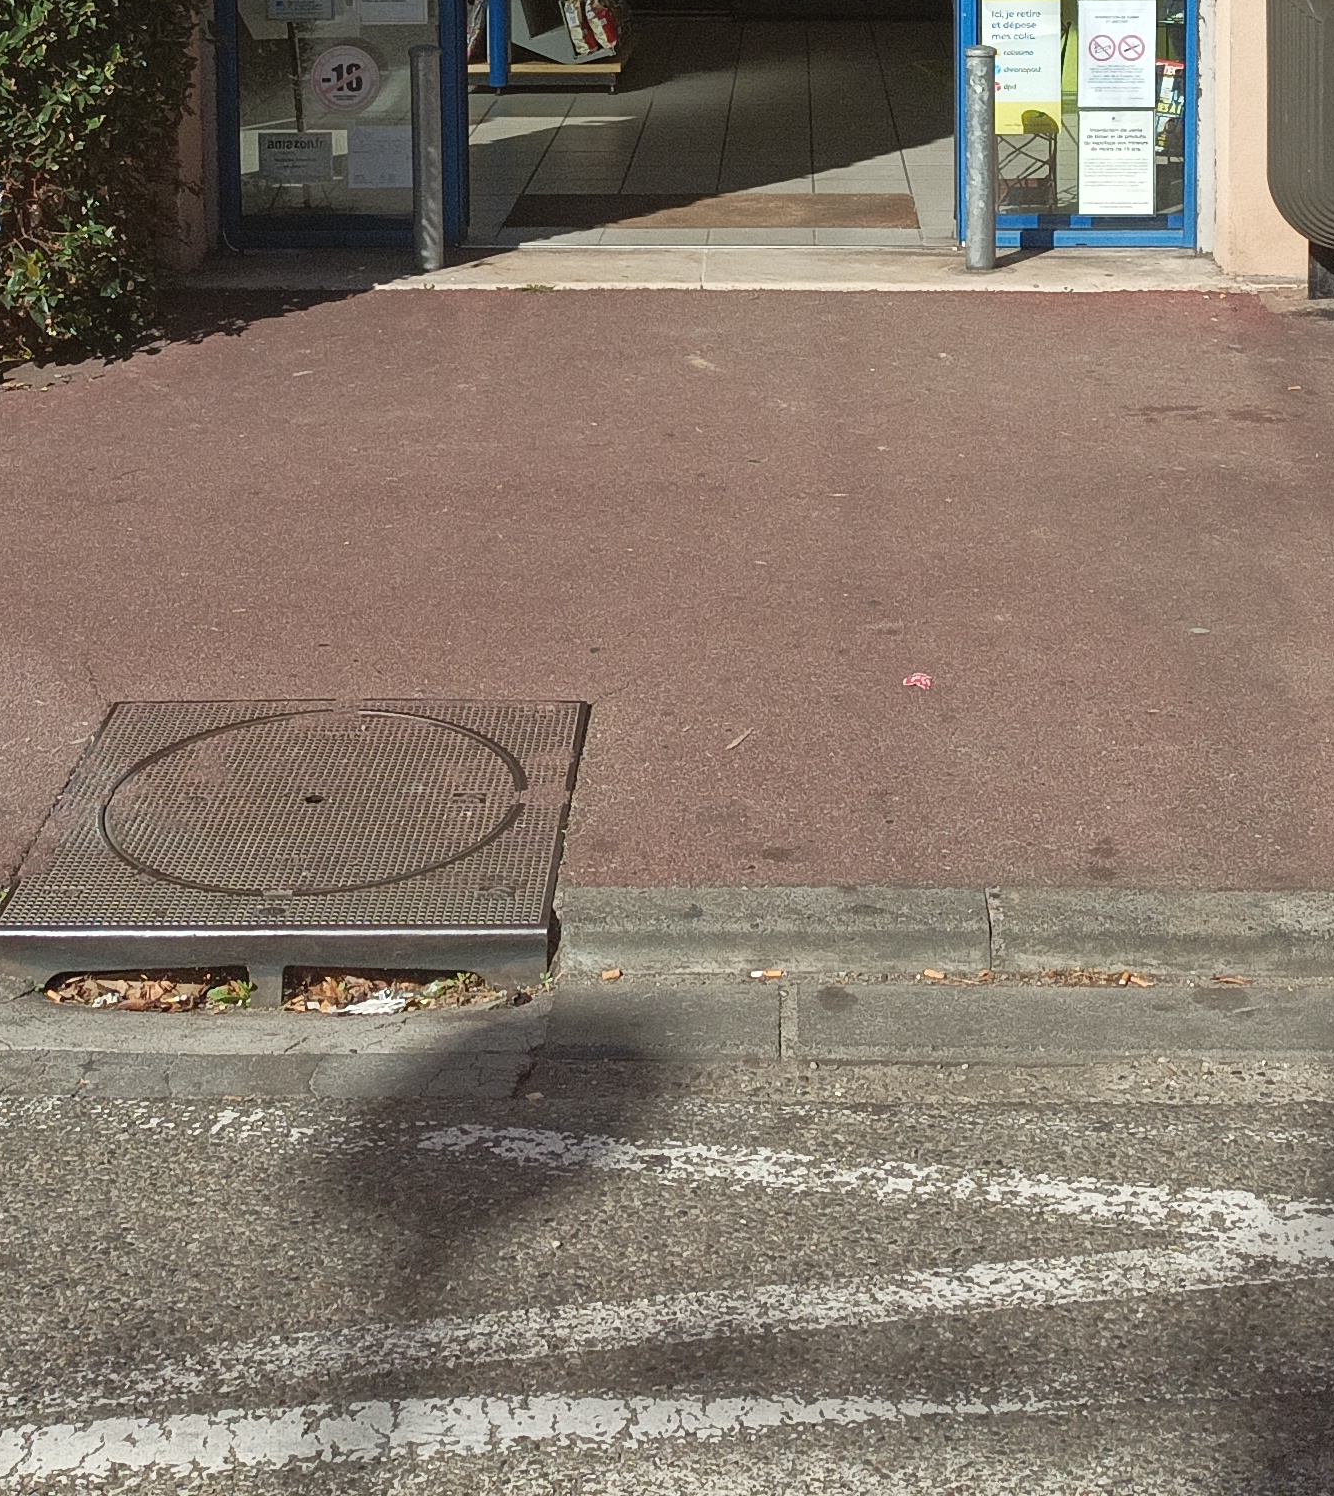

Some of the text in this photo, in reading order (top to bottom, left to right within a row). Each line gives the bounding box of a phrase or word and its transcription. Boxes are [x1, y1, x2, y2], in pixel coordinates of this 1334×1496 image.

[1005, 9, 1015, 20] je
[1016, 9, 1043, 18] retire
[991, 21, 1037, 31] et dépose
[321, 62, 364, 93] -18
